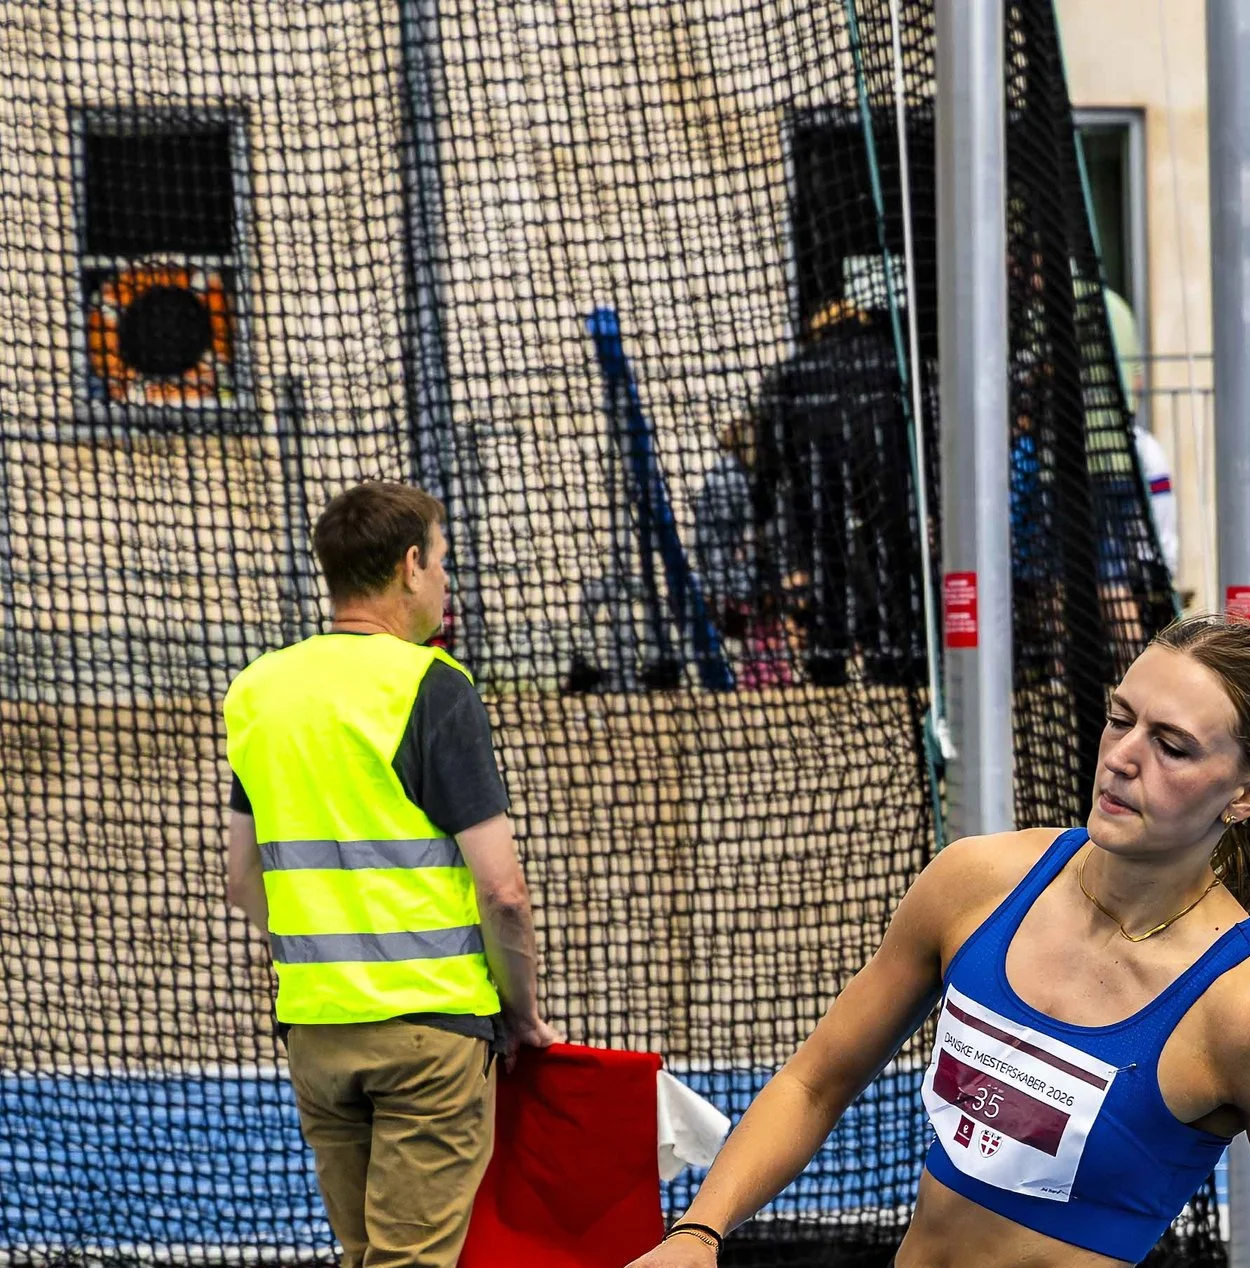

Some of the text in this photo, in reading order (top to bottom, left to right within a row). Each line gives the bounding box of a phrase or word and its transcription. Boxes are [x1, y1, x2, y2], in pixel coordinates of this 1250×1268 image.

[944, 1032, 1075, 1107] DANSKE MESTERSKABER 2026
